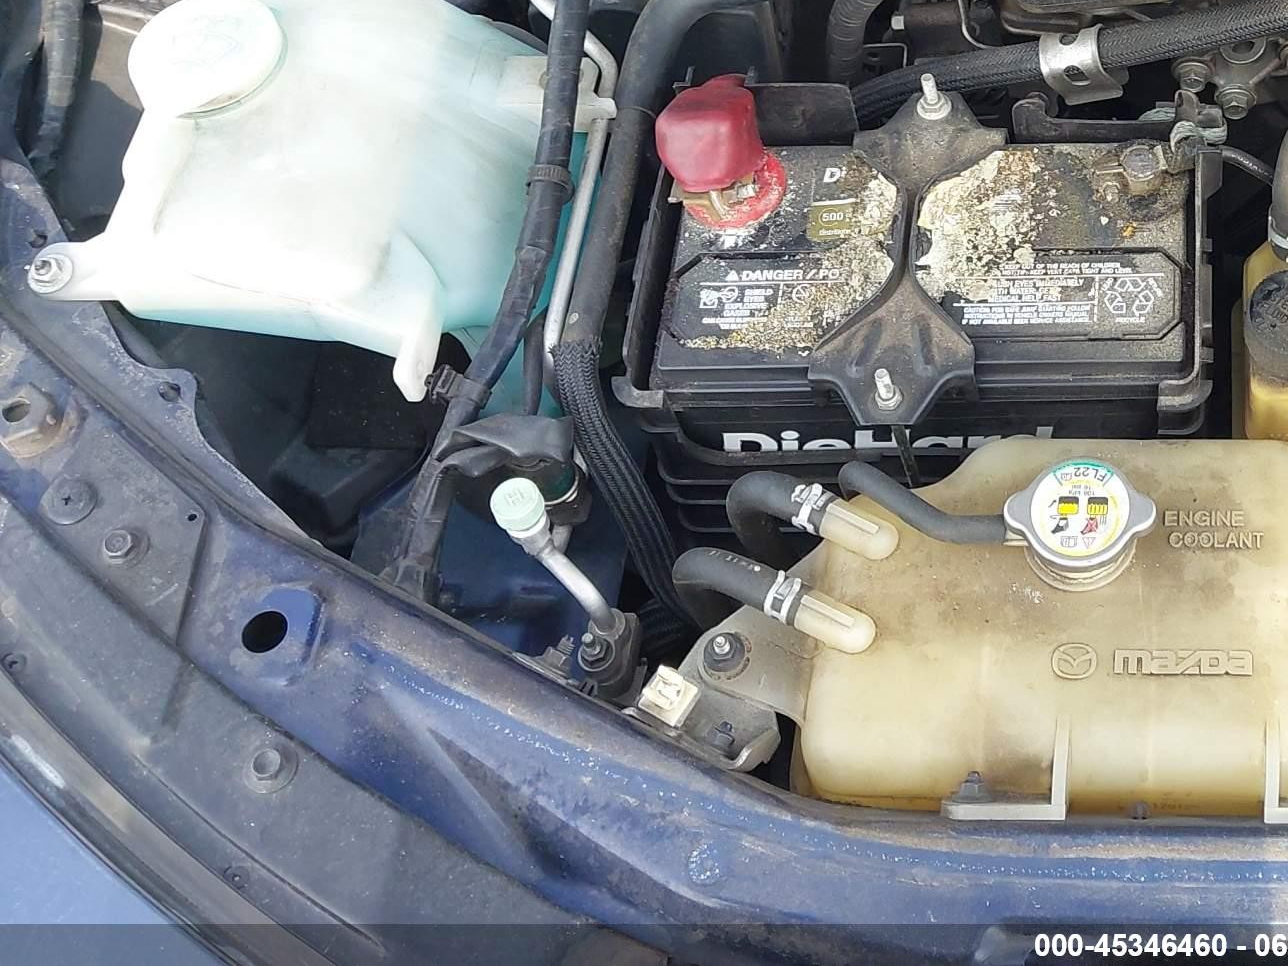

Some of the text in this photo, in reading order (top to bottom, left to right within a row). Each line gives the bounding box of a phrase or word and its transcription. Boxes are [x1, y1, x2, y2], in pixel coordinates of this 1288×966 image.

[741, 270, 803, 281] DANGER
[1073, 467, 1108, 482] FL22
[1163, 509, 1245, 528] ENGINE
[1168, 531, 1264, 549] COOLANT
